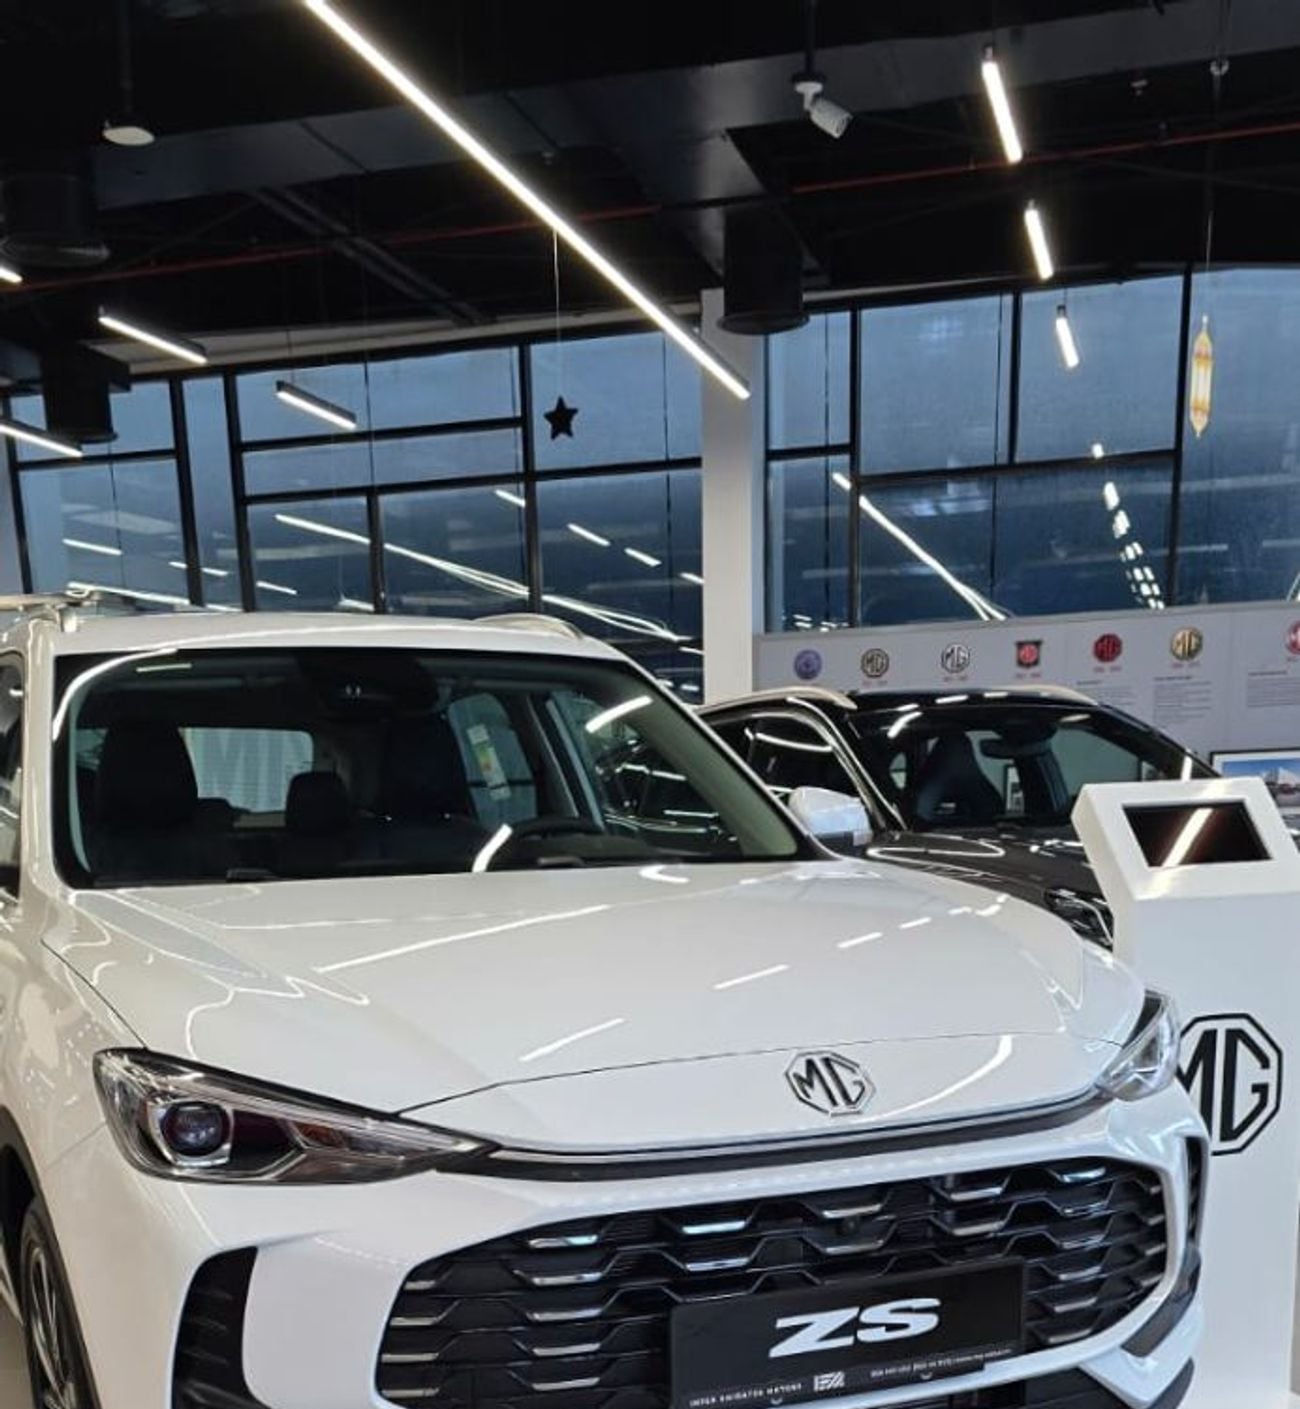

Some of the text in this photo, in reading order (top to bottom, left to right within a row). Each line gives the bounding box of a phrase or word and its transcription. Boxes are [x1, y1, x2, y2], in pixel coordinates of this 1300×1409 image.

[792, 1057, 866, 1107] MG
[1176, 1028, 1270, 1142] MG
[769, 1298, 941, 1358] ZS
